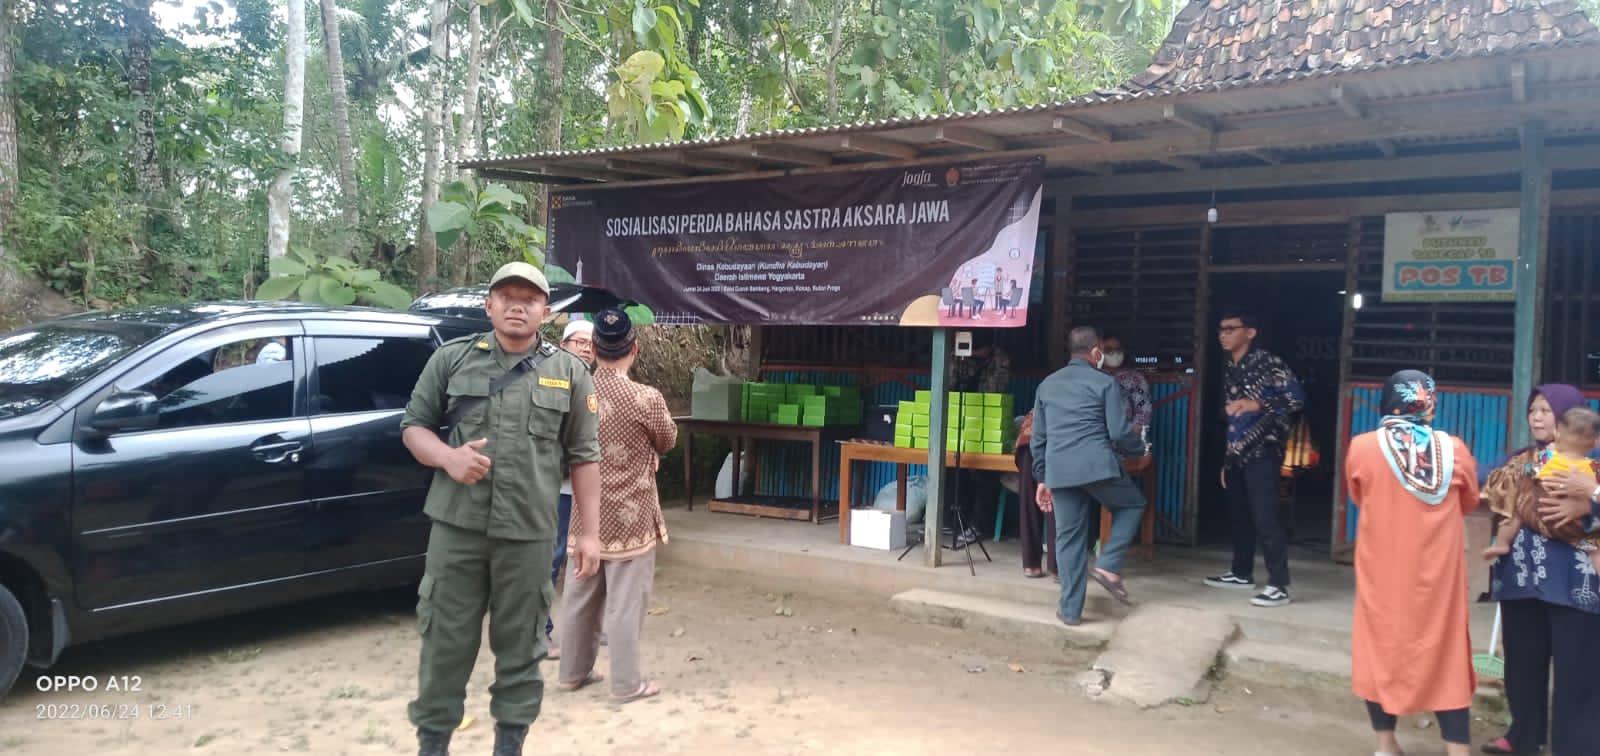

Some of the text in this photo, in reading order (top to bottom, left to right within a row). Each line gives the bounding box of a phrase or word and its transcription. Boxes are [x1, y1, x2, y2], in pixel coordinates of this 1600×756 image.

[606, 199, 950, 237] SOSIALISASI PERDA BAHASA SASTRA AKSARA JAWA
[696, 262, 714, 271] Dinas
[716, 262, 756, 272] Kebudayaan
[1399, 264, 1507, 287] POS TB
[714, 271, 805, 283] Daerah Istimewa Yogyakarta
